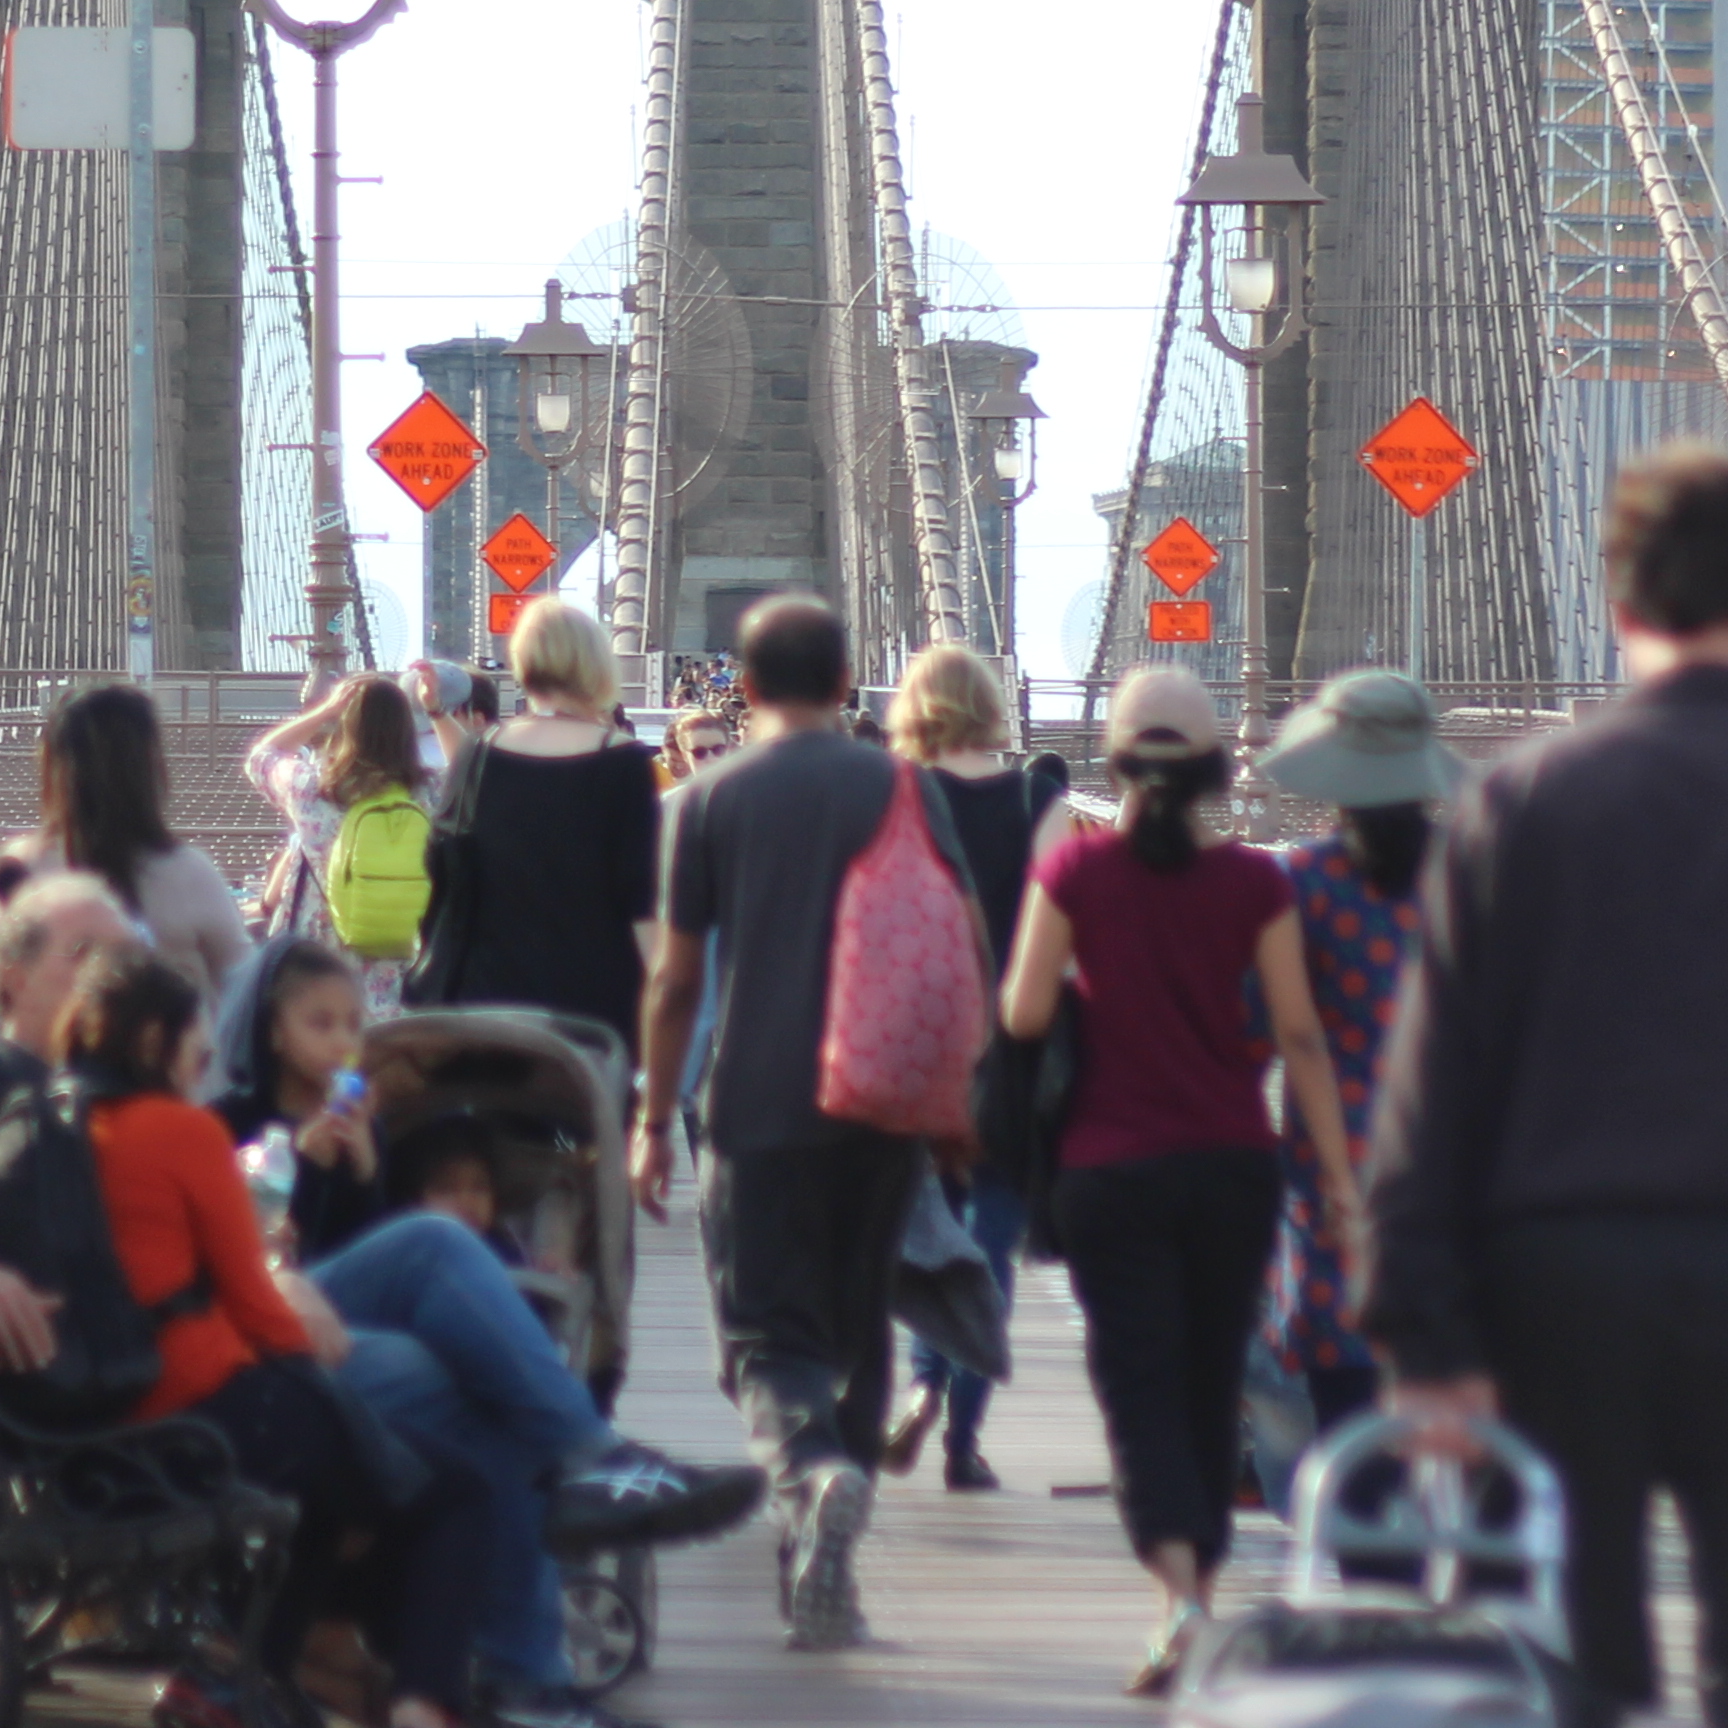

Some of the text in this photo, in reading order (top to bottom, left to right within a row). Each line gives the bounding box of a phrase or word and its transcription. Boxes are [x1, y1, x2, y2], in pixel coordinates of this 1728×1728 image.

[381, 441, 473, 460] WORK ZONE
[1374, 447, 1465, 465] WORK ZONE
[400, 463, 454, 480] AHEAD
[1393, 469, 1446, 486] AHEAD
[506, 538, 532, 550] PATH
[493, 554, 544, 566] NARROWS
